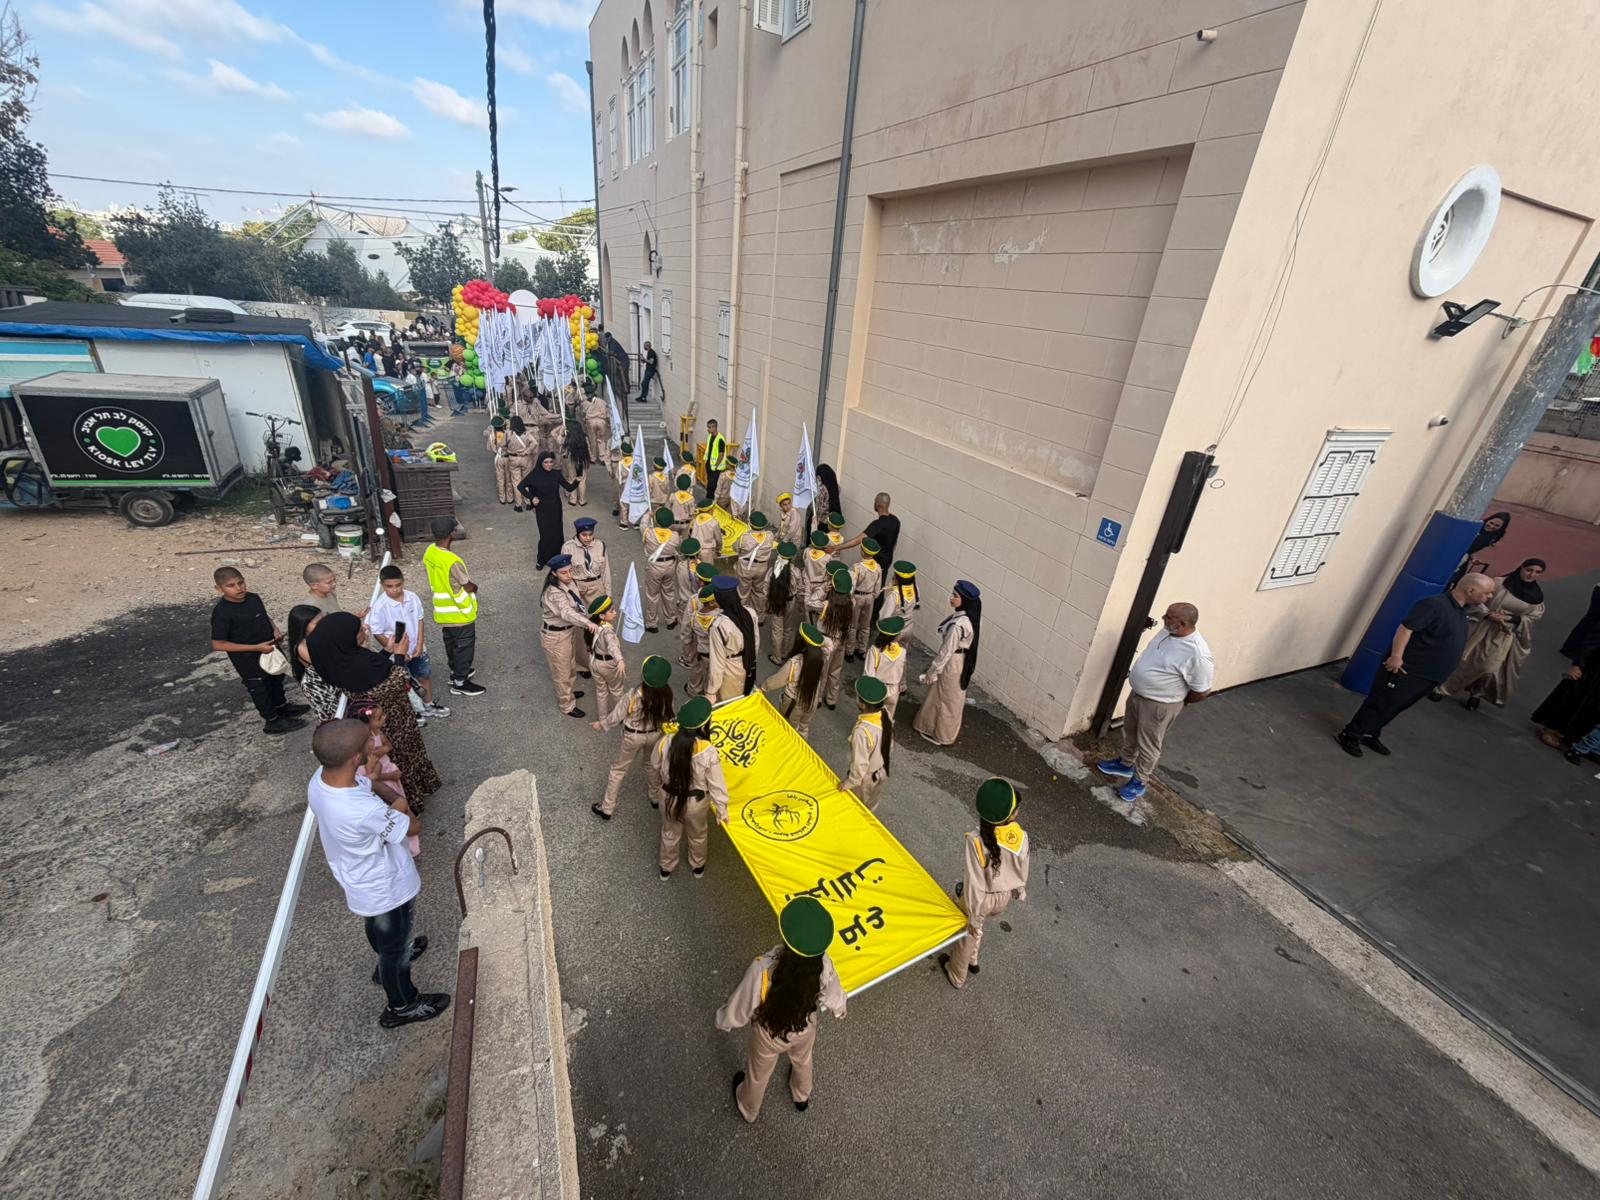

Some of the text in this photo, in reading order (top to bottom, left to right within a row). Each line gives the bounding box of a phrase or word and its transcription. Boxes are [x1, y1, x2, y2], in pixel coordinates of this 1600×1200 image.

[81, 412, 154, 437] קיוסק לב תל אביב
[87, 445, 157, 468] KIOSK LEV TLV
[838, 906, 885, 951] فرع
